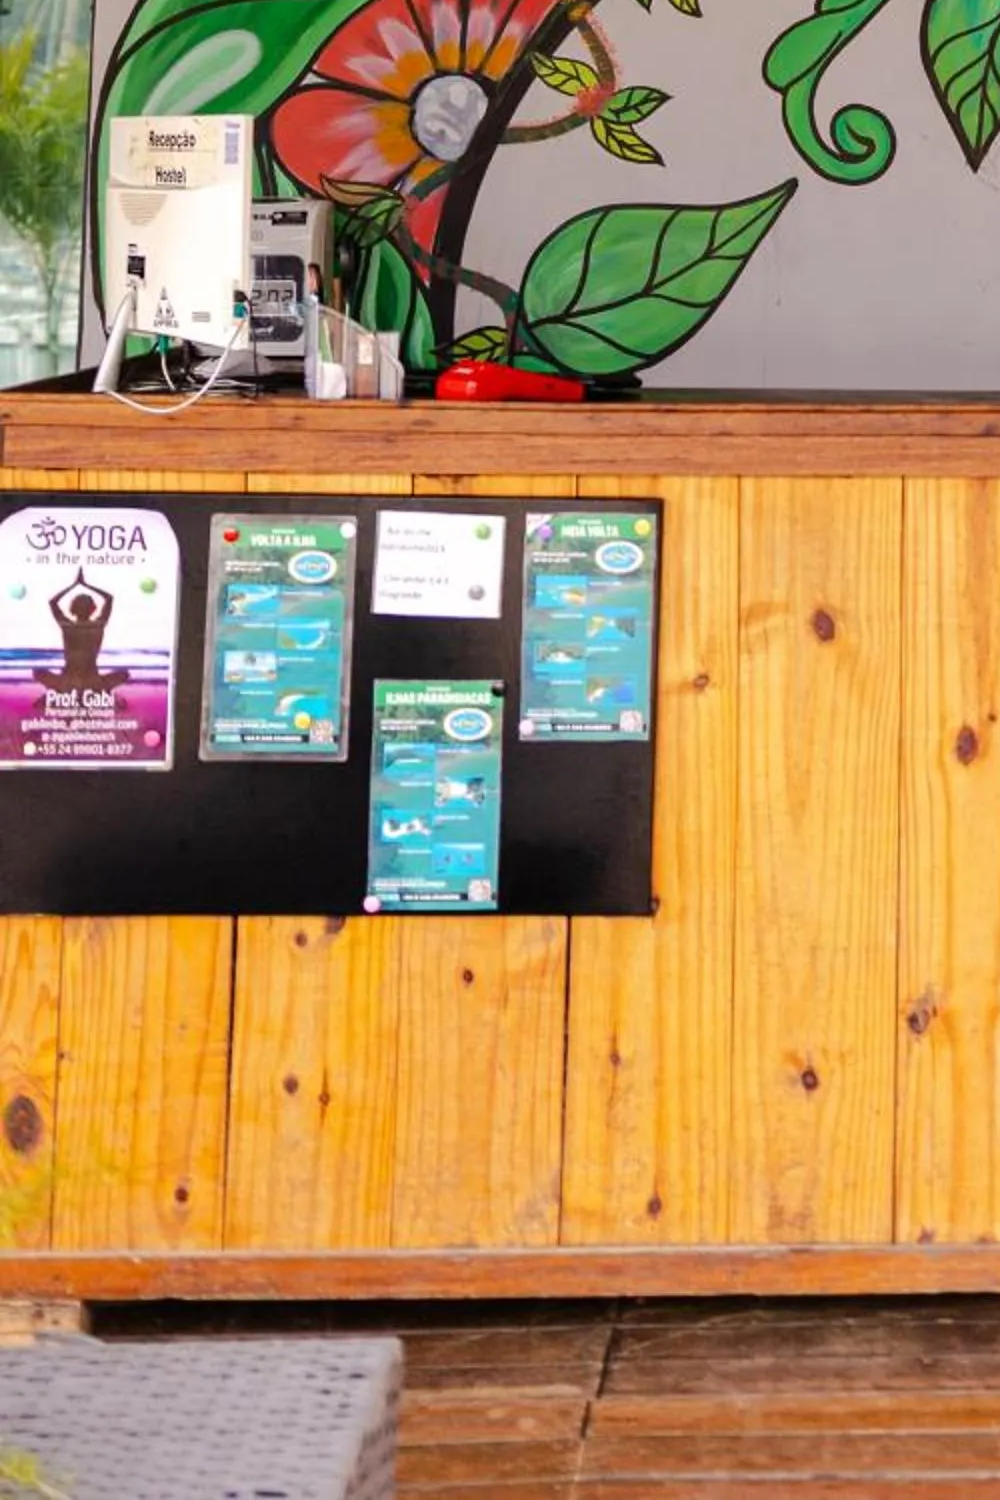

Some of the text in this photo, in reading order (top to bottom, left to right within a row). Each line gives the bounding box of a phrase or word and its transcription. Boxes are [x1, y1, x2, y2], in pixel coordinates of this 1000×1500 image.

[148, 130, 197, 152] Recepção
[155, 166, 187, 184] Hostel
[71, 524, 148, 551] YOGA
[587, 524, 619, 538] VOLTA
[250, 534, 282, 547] VOLTA
[35, 552, 136, 565] in the nature
[45, 688, 115, 708] Prof. Gabi
